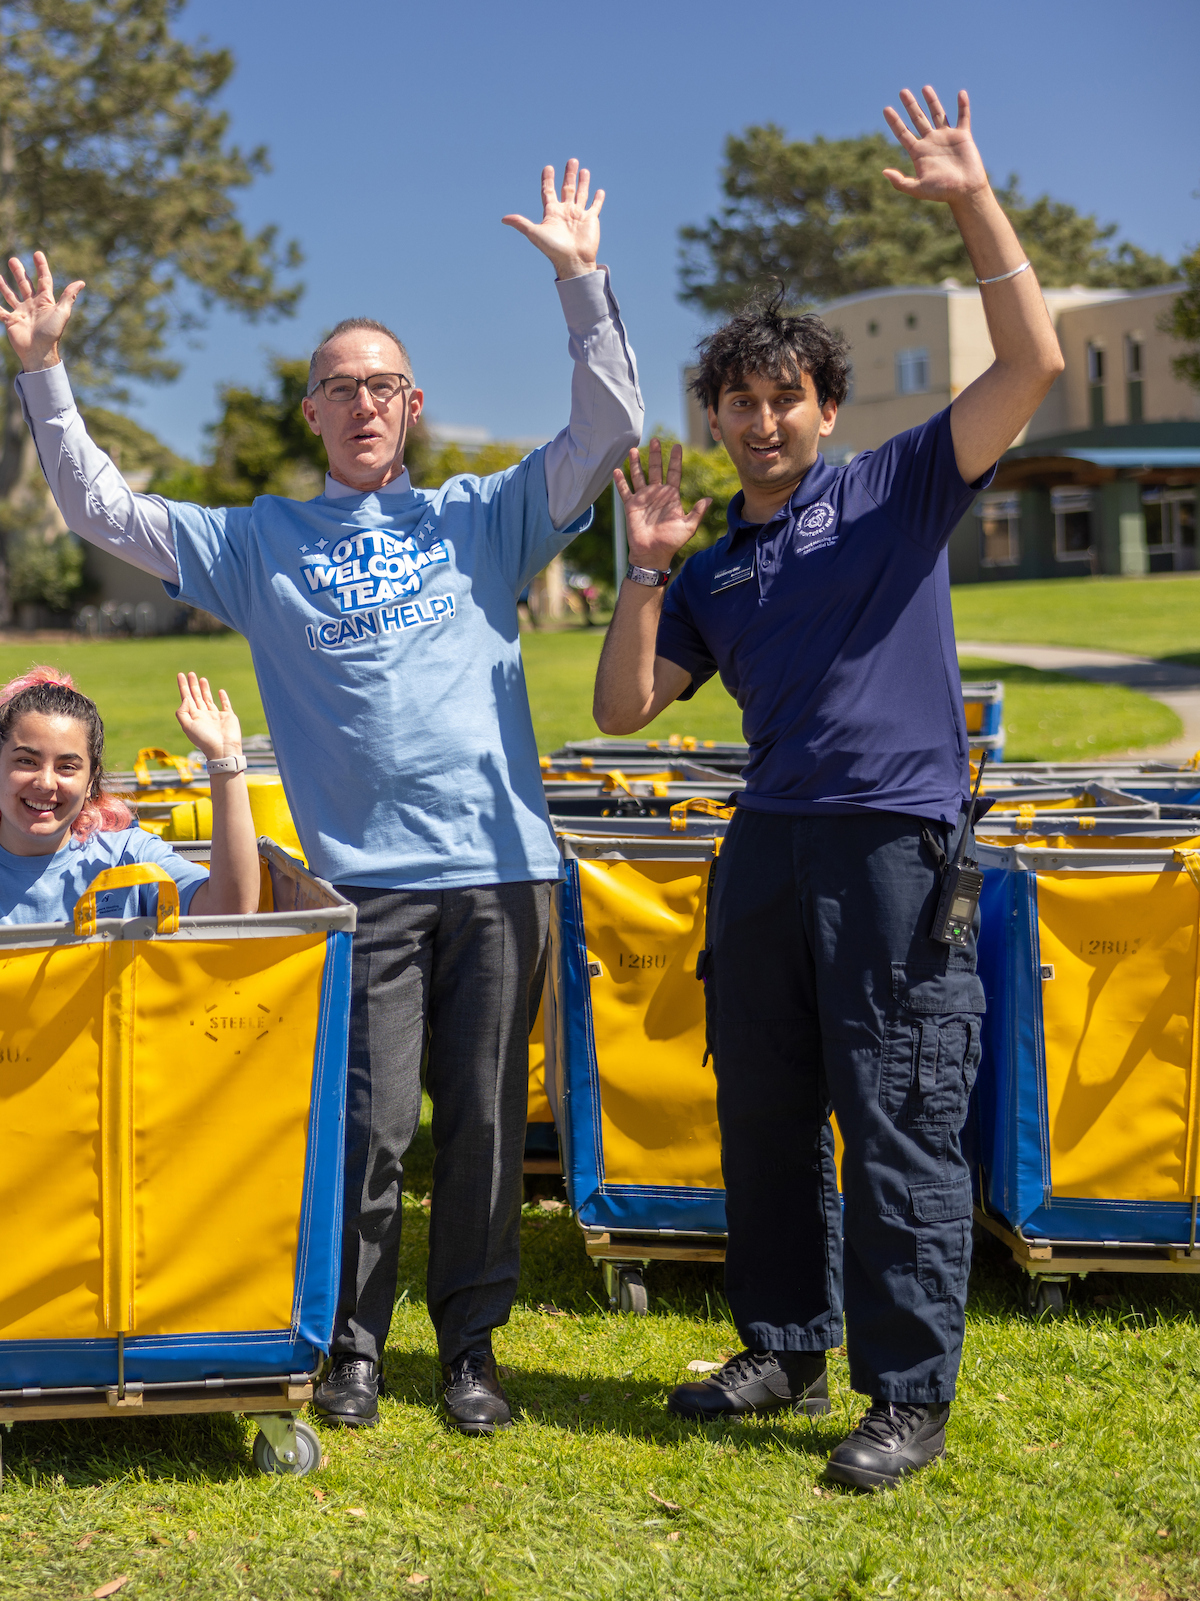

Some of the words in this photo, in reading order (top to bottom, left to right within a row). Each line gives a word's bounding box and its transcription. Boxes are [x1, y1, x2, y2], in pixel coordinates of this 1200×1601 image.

[332, 530, 415, 563] OTTER
[303, 543, 448, 591] WELCOME
[337, 574, 420, 609] TEAM
[306, 626, 316, 649] I
[318, 612, 378, 646] CAN
[381, 596, 455, 631] HELP!
[209, 1016, 265, 1029] STEELE
